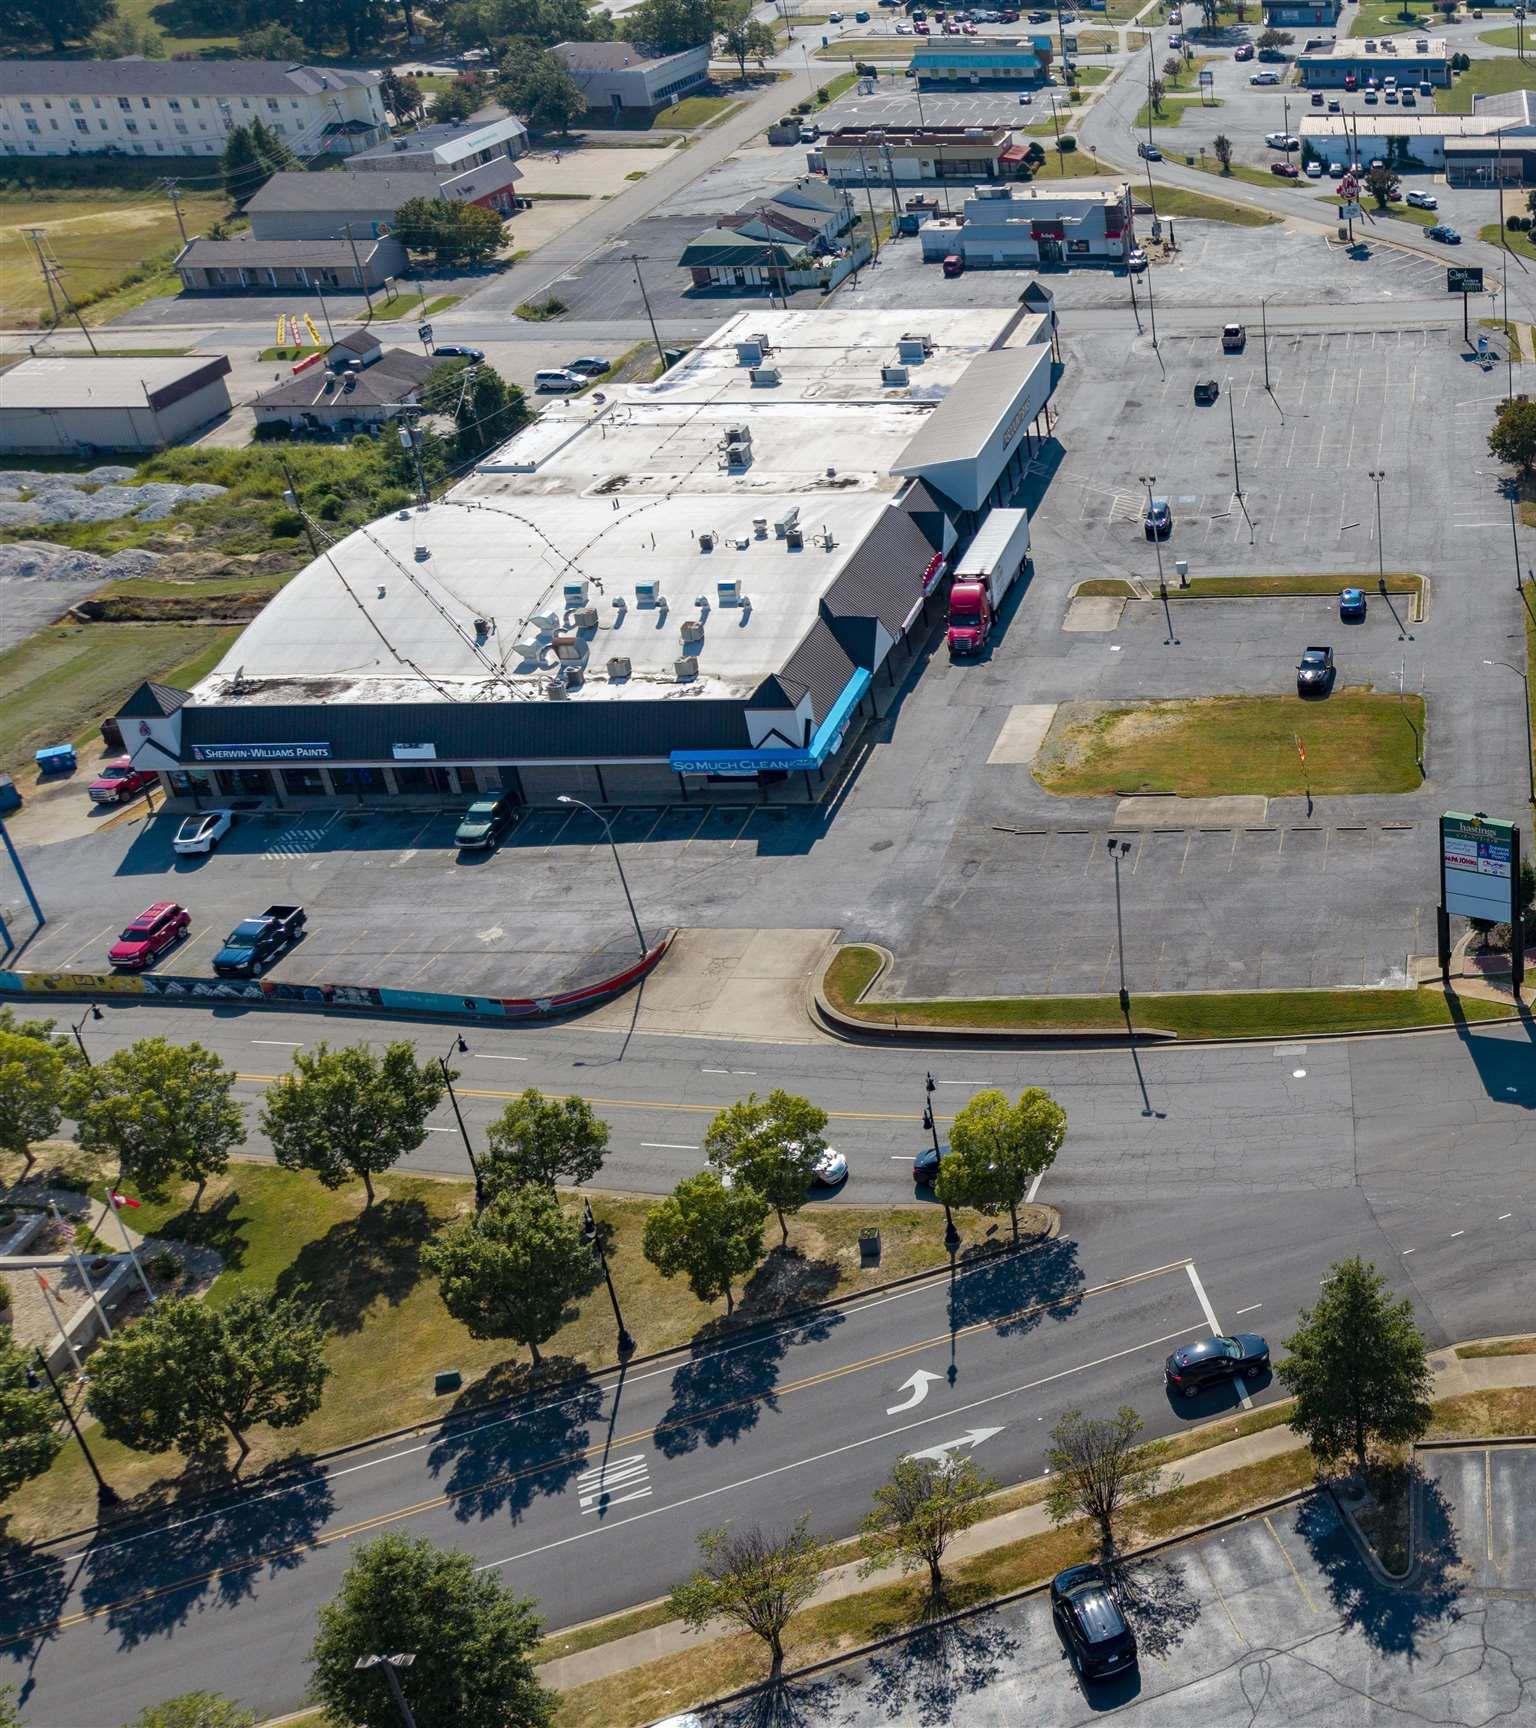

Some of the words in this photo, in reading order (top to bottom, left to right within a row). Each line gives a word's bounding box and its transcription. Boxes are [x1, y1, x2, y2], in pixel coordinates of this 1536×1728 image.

[296, 747, 328, 757] PAINTS
[696, 761, 737, 770] MUCH
[741, 760, 789, 769] CLEAN
[577, 1454, 653, 1515] ONLY
